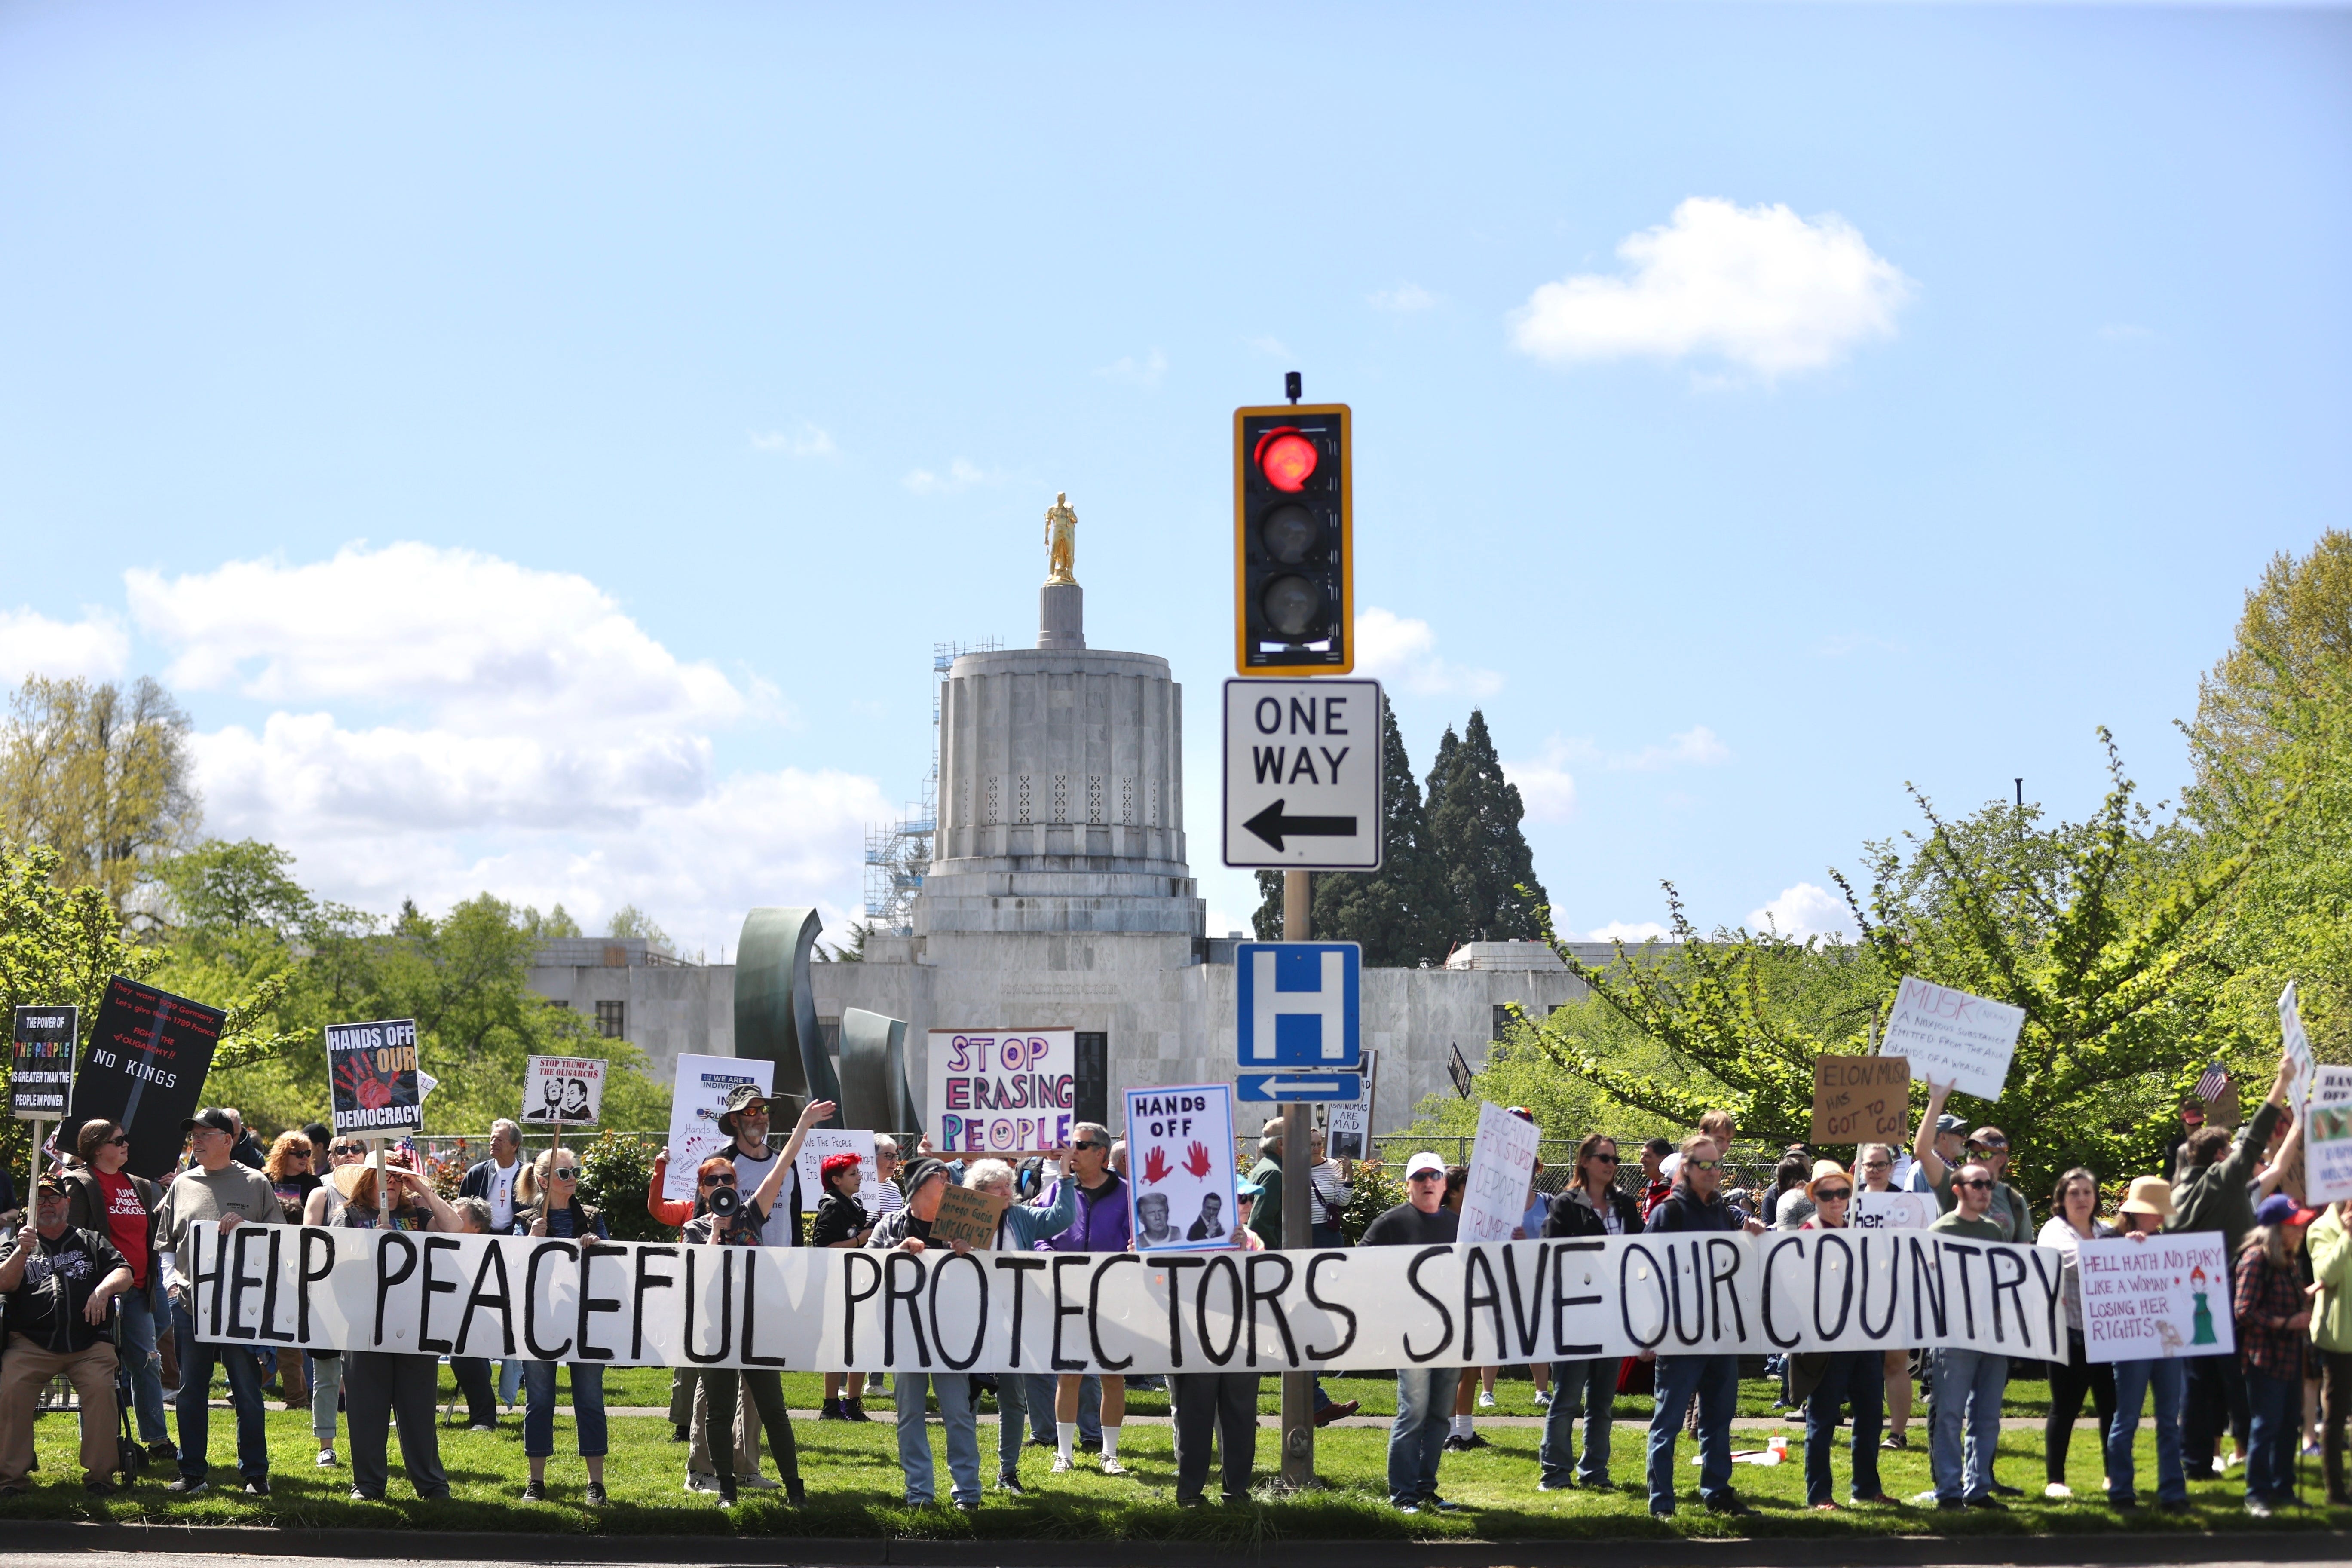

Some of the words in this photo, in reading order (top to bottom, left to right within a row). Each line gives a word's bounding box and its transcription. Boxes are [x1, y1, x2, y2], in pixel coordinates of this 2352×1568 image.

[1254, 697, 1348, 735] ONE
[1252, 746, 1350, 785] WAY
[114, 982, 132, 995] They
[136, 991, 156, 1001] want
[159, 998, 178, 1010] 1939
[179, 1006, 214, 1024] Germany.
[1253, 951, 1344, 1059] H
[1902, 980, 1976, 1023] MUSK
[26, 1017, 37, 1028] THE
[37, 1017, 56, 1028] POWER
[57, 1017, 64, 1028] OF
[115, 998, 132, 1008] Let's
[134, 1005, 151, 1015] give
[152, 1010, 172, 1021] them
[174, 1017, 191, 1027] 1789
[191, 1023, 217, 1038] France.
[1897, 1011, 1909, 1024] A
[1915, 1016, 1954, 1032] NOXIOUS
[1957, 1027, 2006, 1045] SUBSTANCE
[133, 1027, 156, 1038] FIGHT
[160, 1035, 175, 1046] THE
[328, 1027, 382, 1050] HANDS
[386, 1025, 413, 1046] OFF
[1891, 1024, 1933, 1043] EMITTED
[1939, 1036, 1962, 1051] FROM
[1984, 1047, 2009, 1063] ANAL
[15, 1042, 32, 1058] THE
[35, 1042, 70, 1058] PEOPLE
[377, 1046, 416, 1073] OUR
[947, 1035, 1048, 1072] STOP
[1885, 1041, 1924, 1060] GLANDS
[1928, 1053, 1940, 1063] OF
[1941, 1057, 1948, 1065] A
[1952, 1060, 1988, 1077] WEASEL
[93, 1049, 116, 1068] NO
[125, 1059, 177, 1088] KINGS
[562, 1060, 587, 1069] TRUMP
[1824, 1063, 1873, 1086] ELON
[1877, 1062, 1906, 1084] MUSK
[12, 1071, 18, 1083] IS
[18, 1071, 43, 1083] GREATER
[44, 1071, 59, 1083] THAN
[59, 1071, 70, 1083] THE
[15, 1094, 37, 1106] PEOPLE
[37, 1094, 43, 1106] IN
[43, 1094, 63, 1106] POWER
[946, 1074, 1074, 1110] ERASING
[1826, 1091, 1850, 1110] HAS
[2323, 1090, 2348, 1100] OFF
[336, 1105, 420, 1129] DEMOCRACY
[1135, 1096, 1205, 1117] HANDS
[1340, 1111, 1358, 1121] ARE
[1828, 1110, 1861, 1135] GOT
[1865, 1099, 1885, 1117] TO
[686, 1122, 710, 1134] Hands
[942, 1114, 1071, 1152] PEOPLE
[1150, 1118, 1191, 1138] OFF
[1333, 1119, 1359, 1130] MAD
[1481, 1130, 1502, 1157] FIX
[1504, 1142, 1532, 1170] STUPID
[116, 1188, 137, 1197] FUND
[861, 1191, 877, 1200] BOOKER
[946, 1188, 960, 1200] Free
[961, 1192, 988, 1208] Kilmar
[1476, 1163, 1524, 1212] DEPORT
[109, 1205, 146, 1215] SCHOOLS
[932, 1218, 974, 1243] IMPEACH
[2083, 1255, 2119, 1274] HELL
[2122, 1253, 2158, 1271] HATH
[2164, 1250, 2184, 1269] NO
[2186, 1248, 2222, 1267] FURY
[2085, 1279, 2113, 1295] LIKE
[2117, 1279, 2126, 1293] A
[2128, 1275, 2169, 1292] WOMAN
[194, 1225, 335, 1344] HELP
[374, 1231, 786, 1366] PEACEFUL
[844, 1252, 1357, 1371] PROTECTORS
[1403, 1241, 1605, 1363] SAVE
[1620, 1239, 1746, 1348] OUR
[1761, 1234, 2062, 1355] COUNTRY
[2089, 1300, 2135, 1318] LOSING
[2140, 1296, 2170, 1314] HER
[2092, 1317, 2154, 1341] RIGHTS
